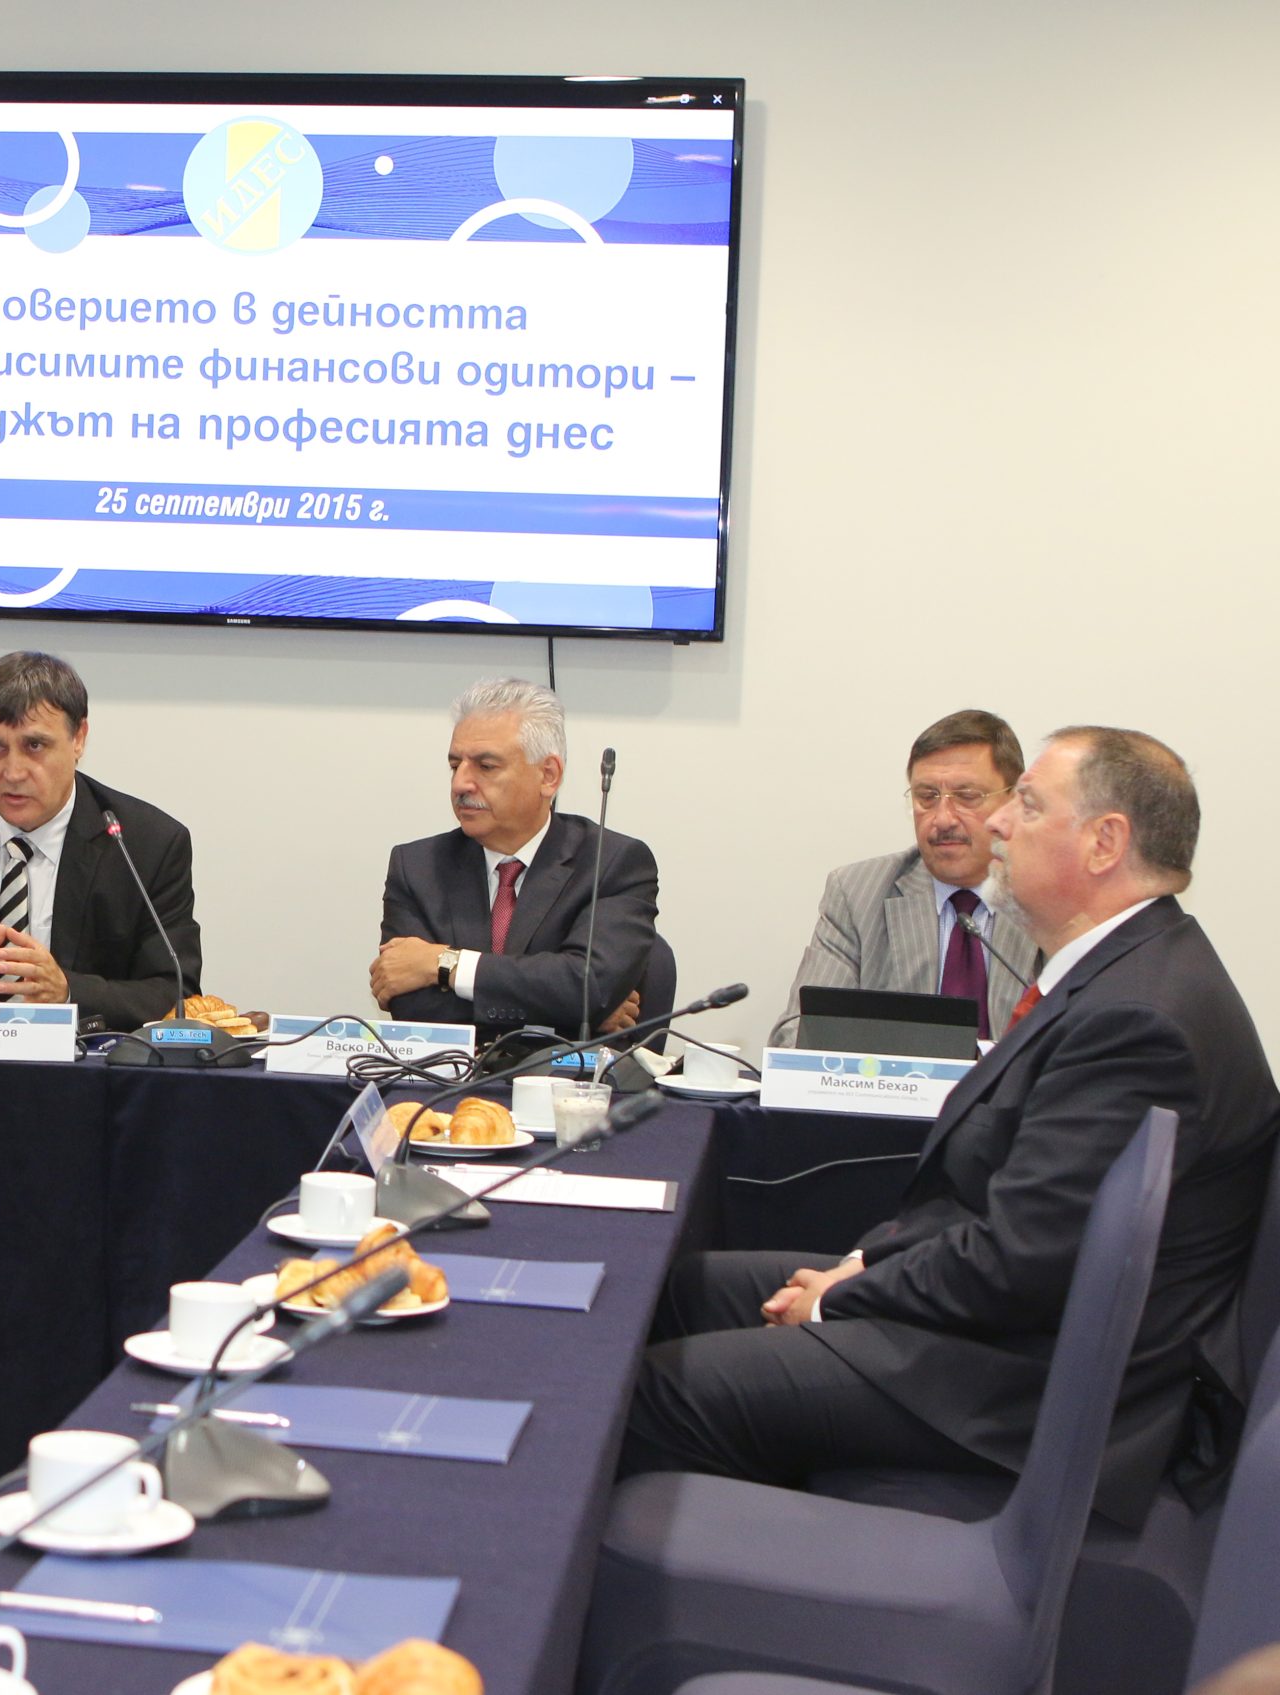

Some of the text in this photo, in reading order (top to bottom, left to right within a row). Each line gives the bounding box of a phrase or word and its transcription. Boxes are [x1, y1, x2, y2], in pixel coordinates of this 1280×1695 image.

[199, 131, 307, 239] ИДЕС
[233, 291, 257, 325] в
[272, 294, 527, 335] дейността
[199, 347, 441, 390] финансови
[457, 361, 655, 399] одитори
[131, 412, 180, 440] на
[199, 407, 489, 452] професията
[506, 421, 614, 459] днес
[95, 486, 389, 524] 25 септември 2015 г.
[326, 1040, 413, 1055] Васко Рачев
[820, 1075, 919, 1094] Максим Бехар
